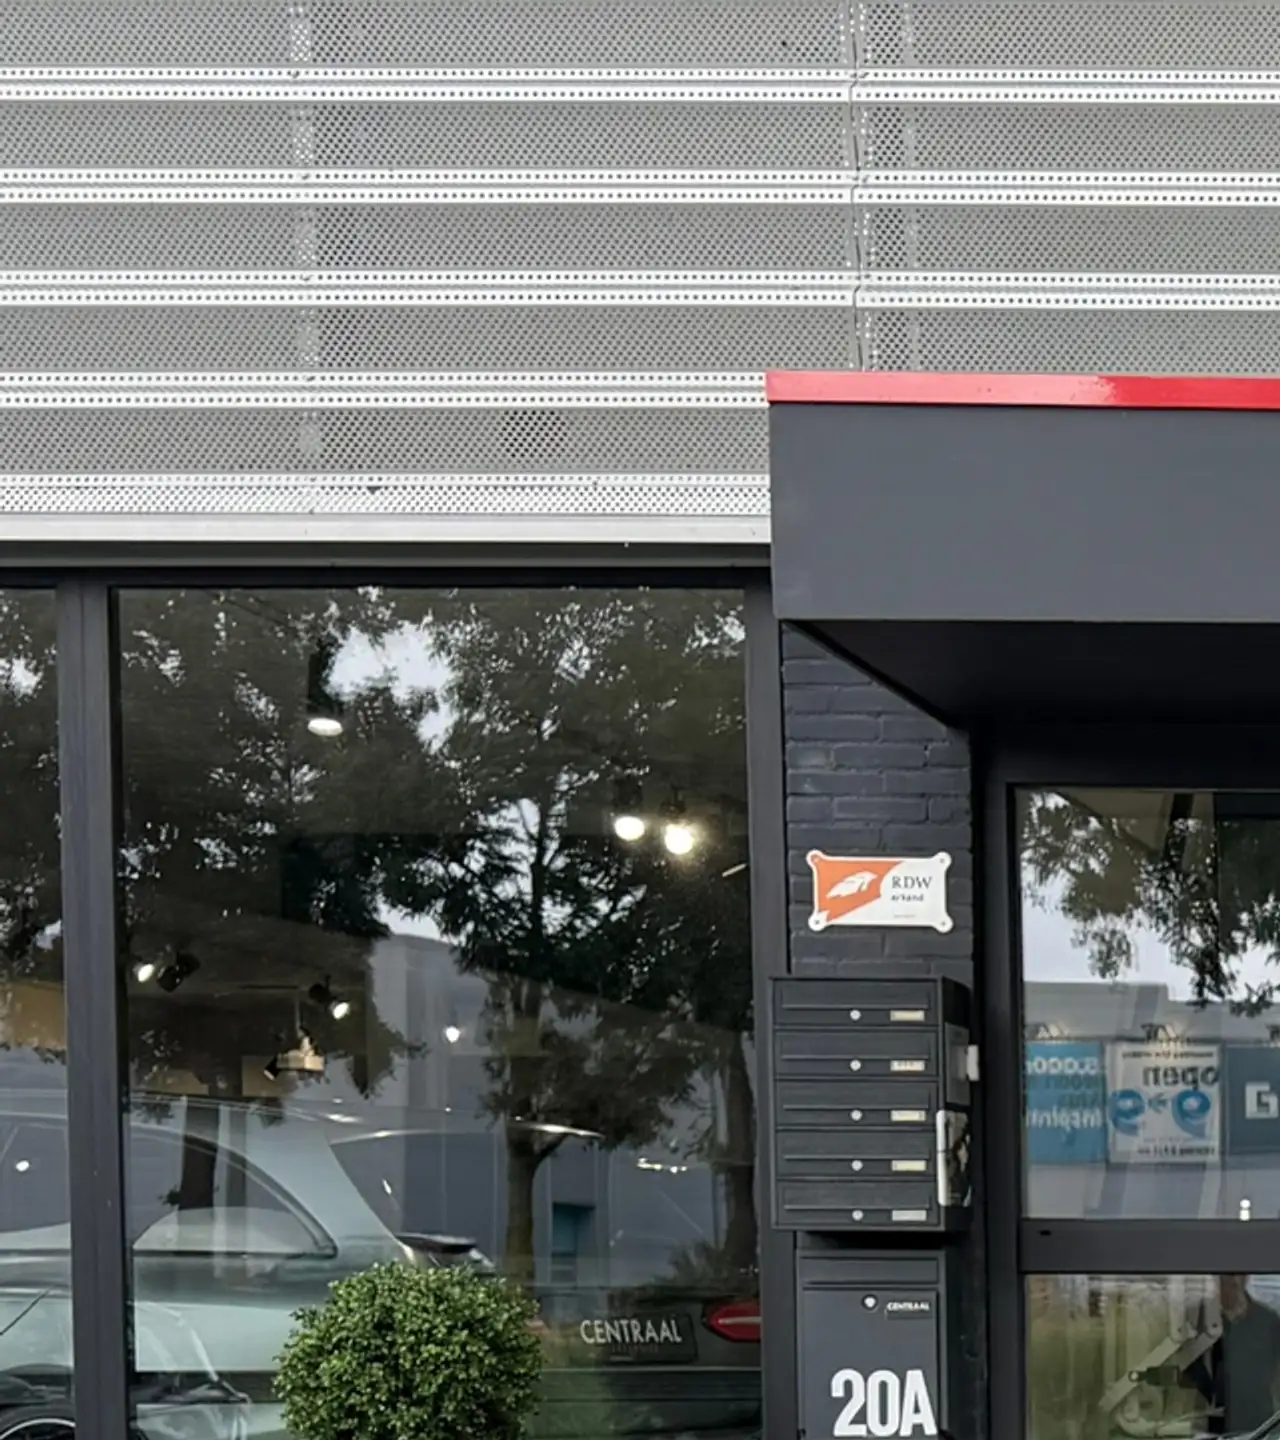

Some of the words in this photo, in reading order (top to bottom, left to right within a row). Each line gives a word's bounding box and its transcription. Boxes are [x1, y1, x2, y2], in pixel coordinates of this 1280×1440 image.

[891, 875, 933, 889] RDW
[886, 1301, 931, 1312] CENTRAAL
[580, 1319, 683, 1344] CENTRAAL
[831, 1368, 938, 1437] 20A
